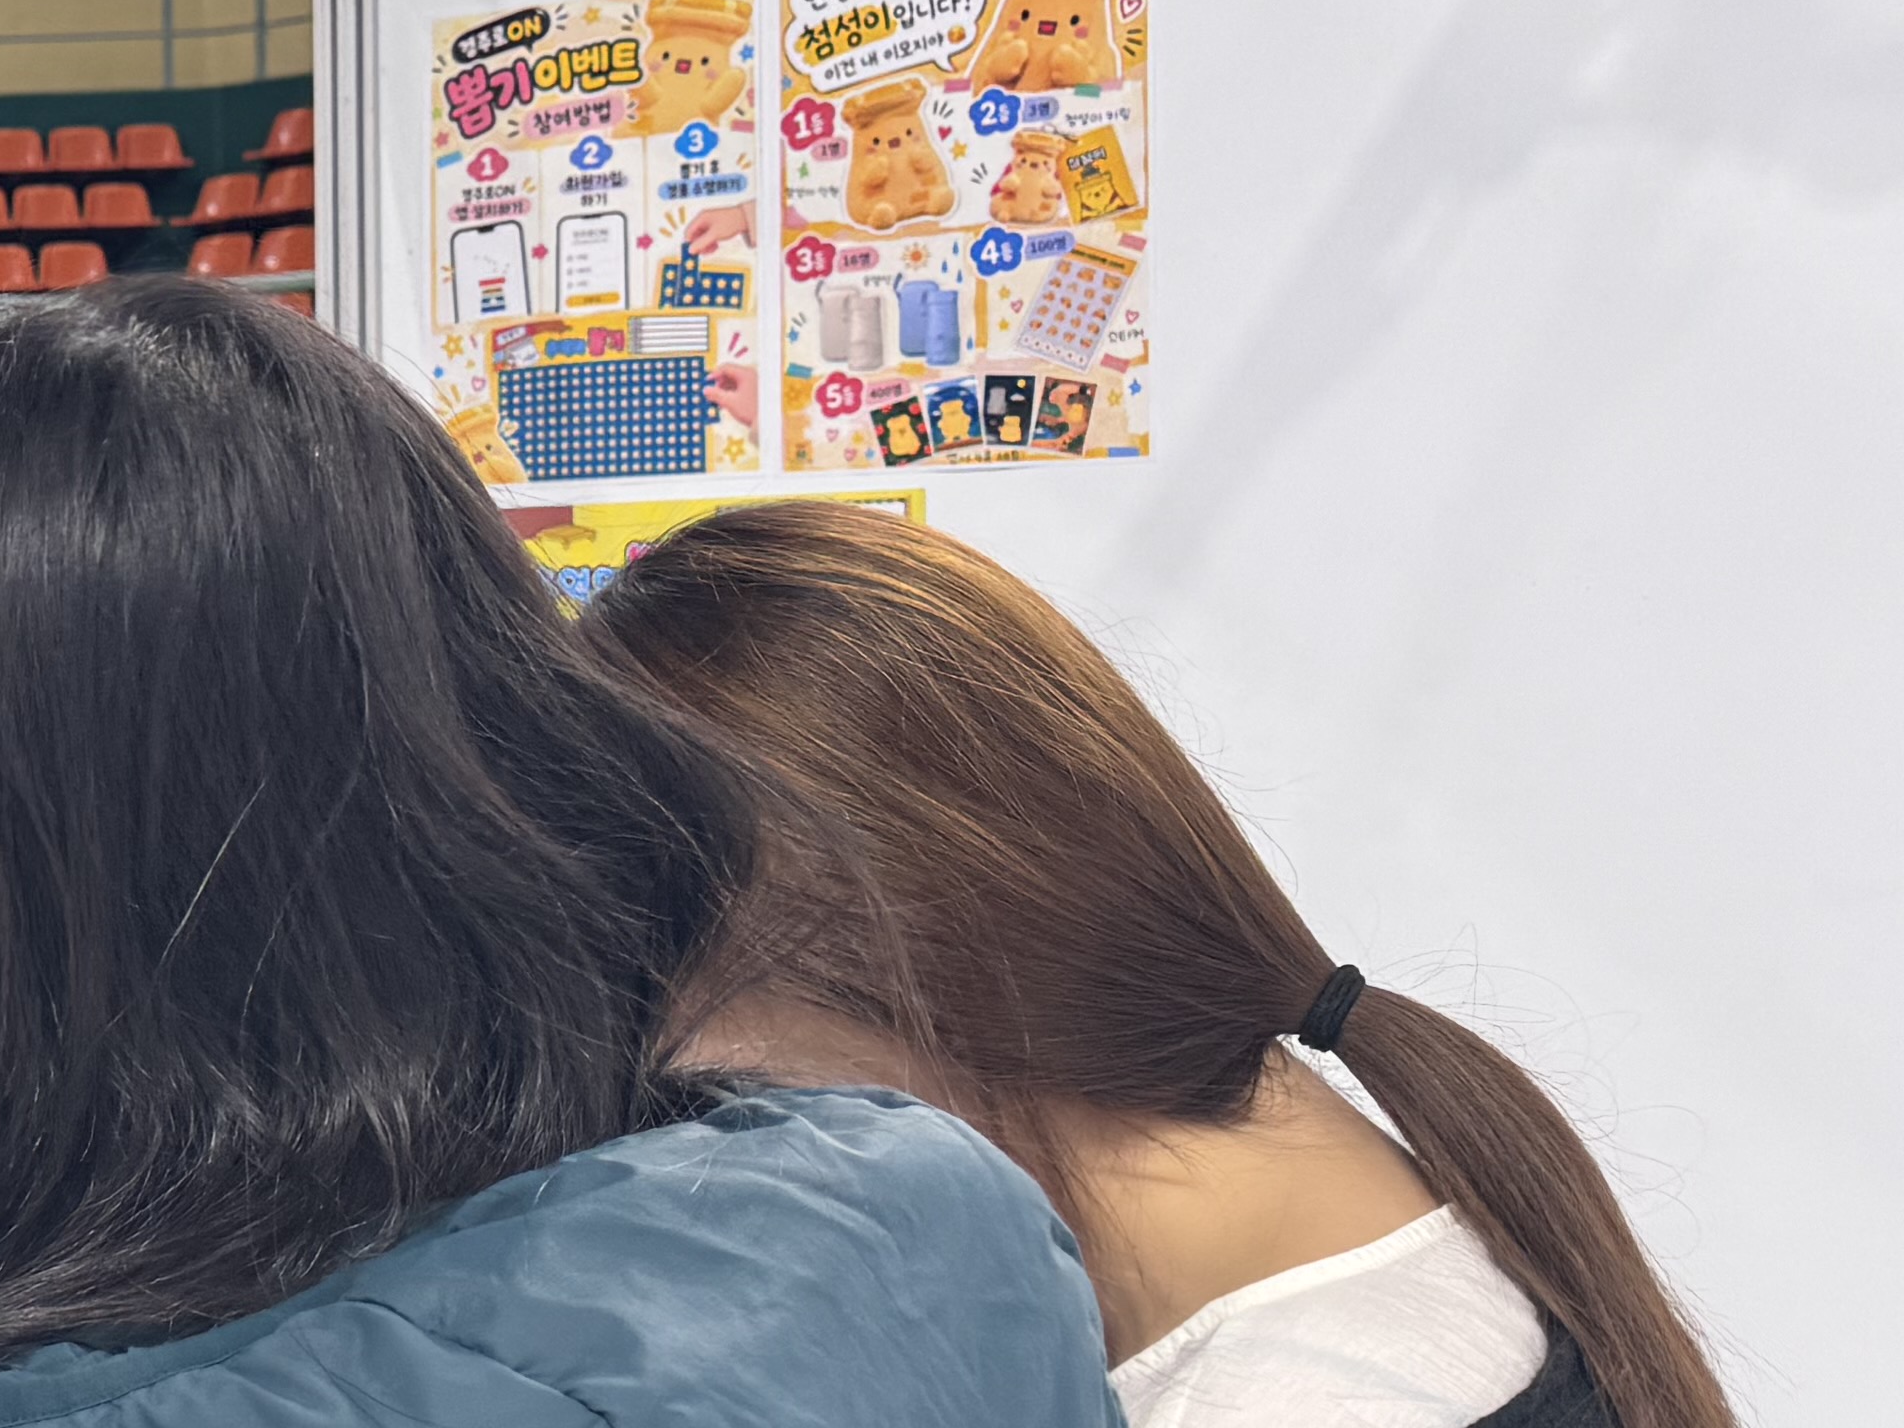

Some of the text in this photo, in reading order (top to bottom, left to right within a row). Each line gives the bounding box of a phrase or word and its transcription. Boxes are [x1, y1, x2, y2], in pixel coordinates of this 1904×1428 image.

[458, 16, 542, 59] 경주로ON
[825, 61, 856, 81] 이건
[861, 51, 877, 67] 내
[688, 129, 705, 152] 3
[583, 142, 599, 164] 2
[481, 154, 493, 176] 1
